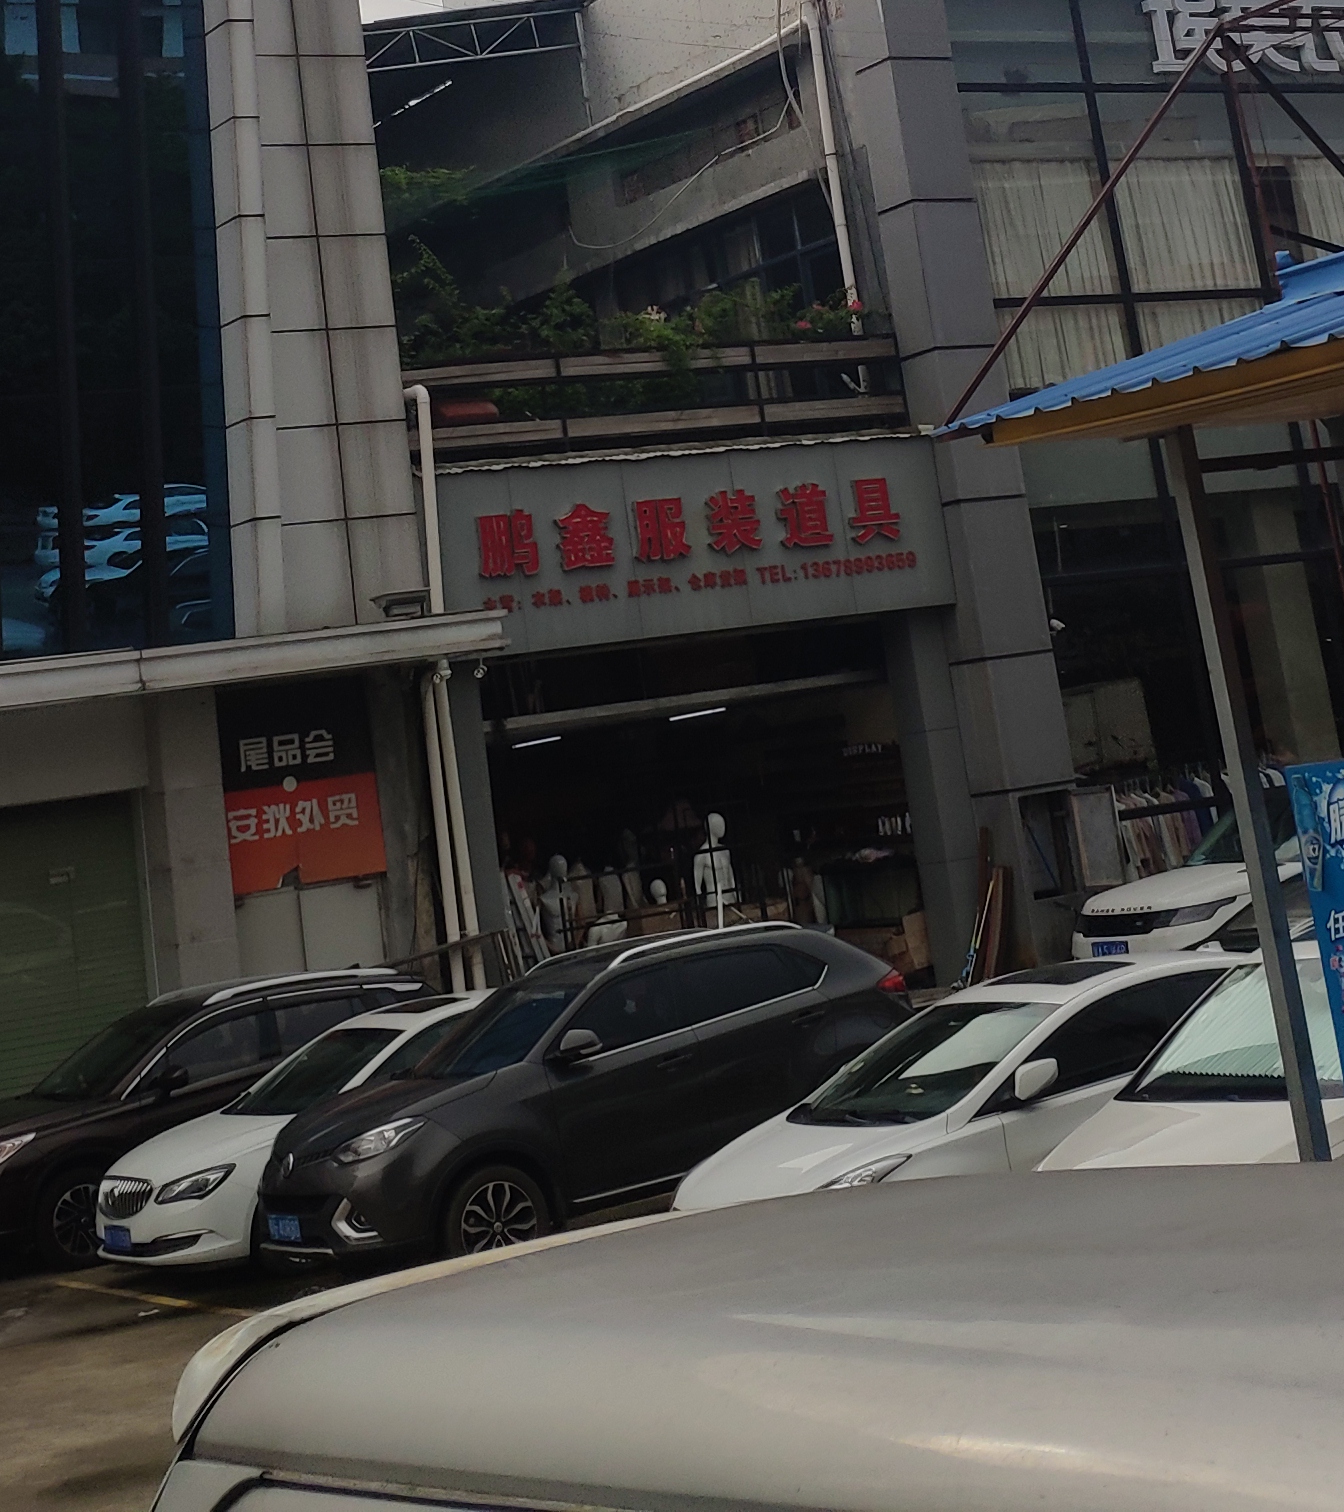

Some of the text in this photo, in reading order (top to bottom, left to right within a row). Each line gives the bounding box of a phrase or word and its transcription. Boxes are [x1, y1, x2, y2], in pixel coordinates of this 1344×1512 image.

[476, 476, 902, 578] 鹏鑫服装道具
[239, 729, 335, 773] 尾品会
